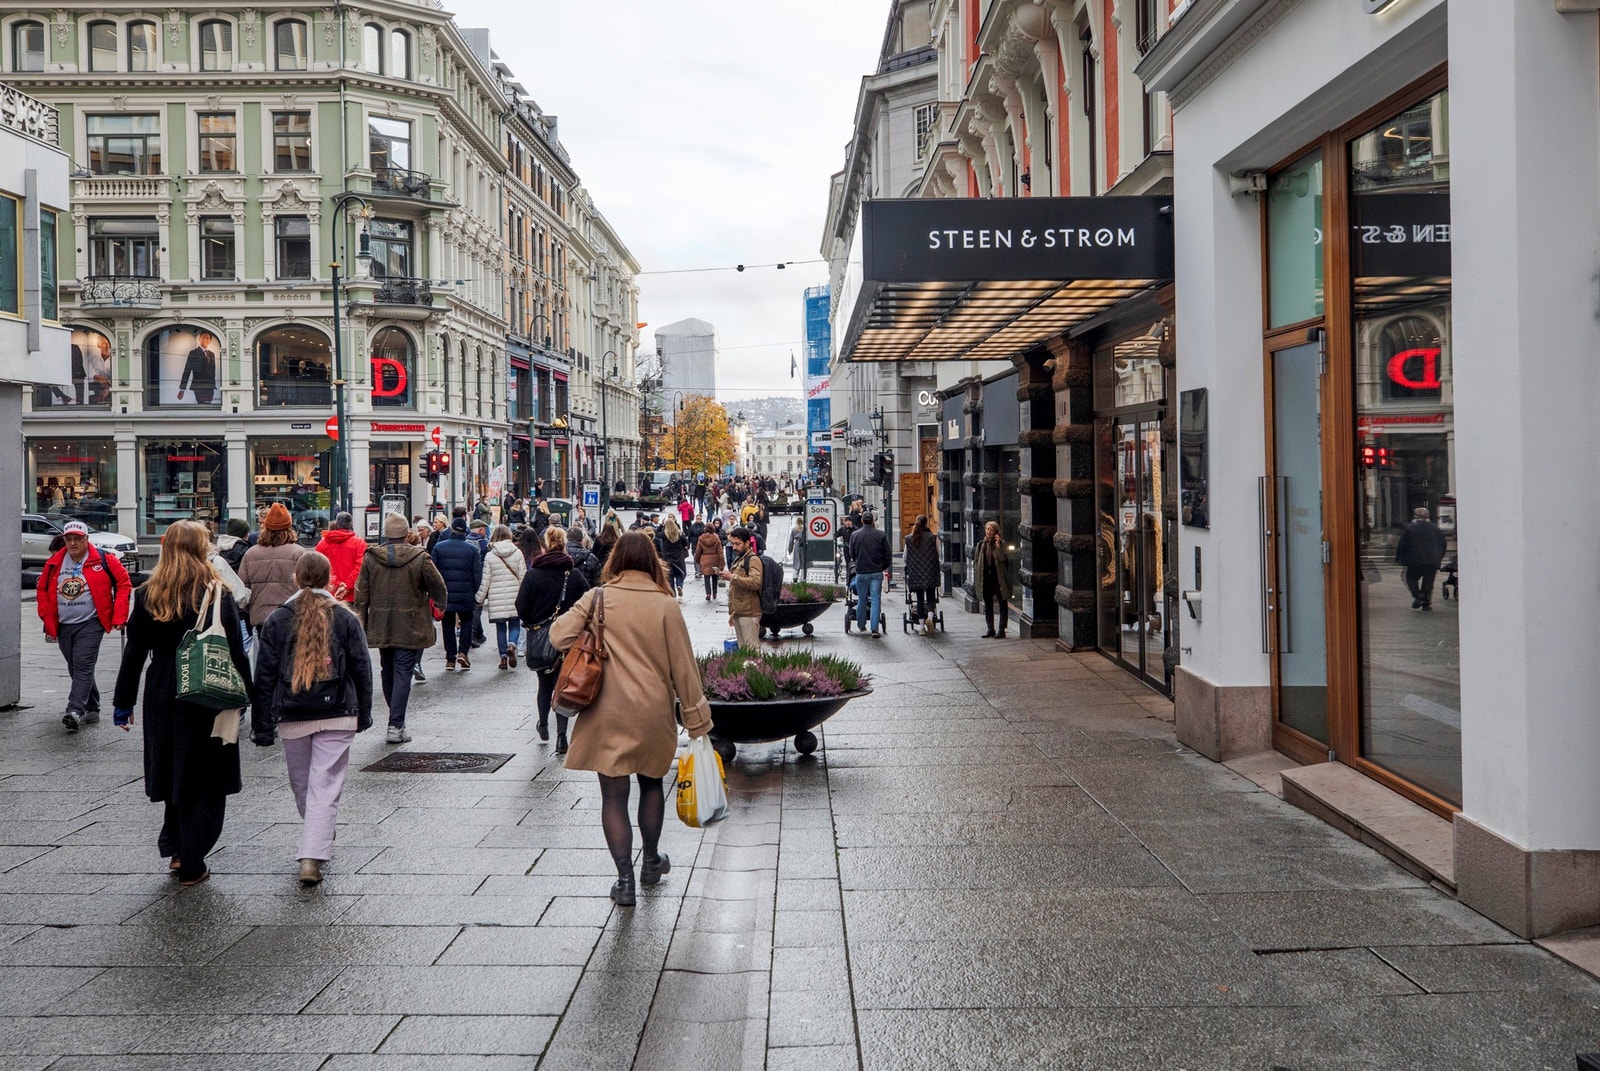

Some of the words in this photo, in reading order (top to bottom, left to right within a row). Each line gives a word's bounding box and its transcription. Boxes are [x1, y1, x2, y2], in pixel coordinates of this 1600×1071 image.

[928, 230, 1012, 249] STEEN
[1020, 229, 1038, 248] &
[1044, 228, 1136, 248] STRØM
[371, 357, 407, 397] D
[813, 521, 828, 533] 30
[181, 663, 190, 693] BOOKS
